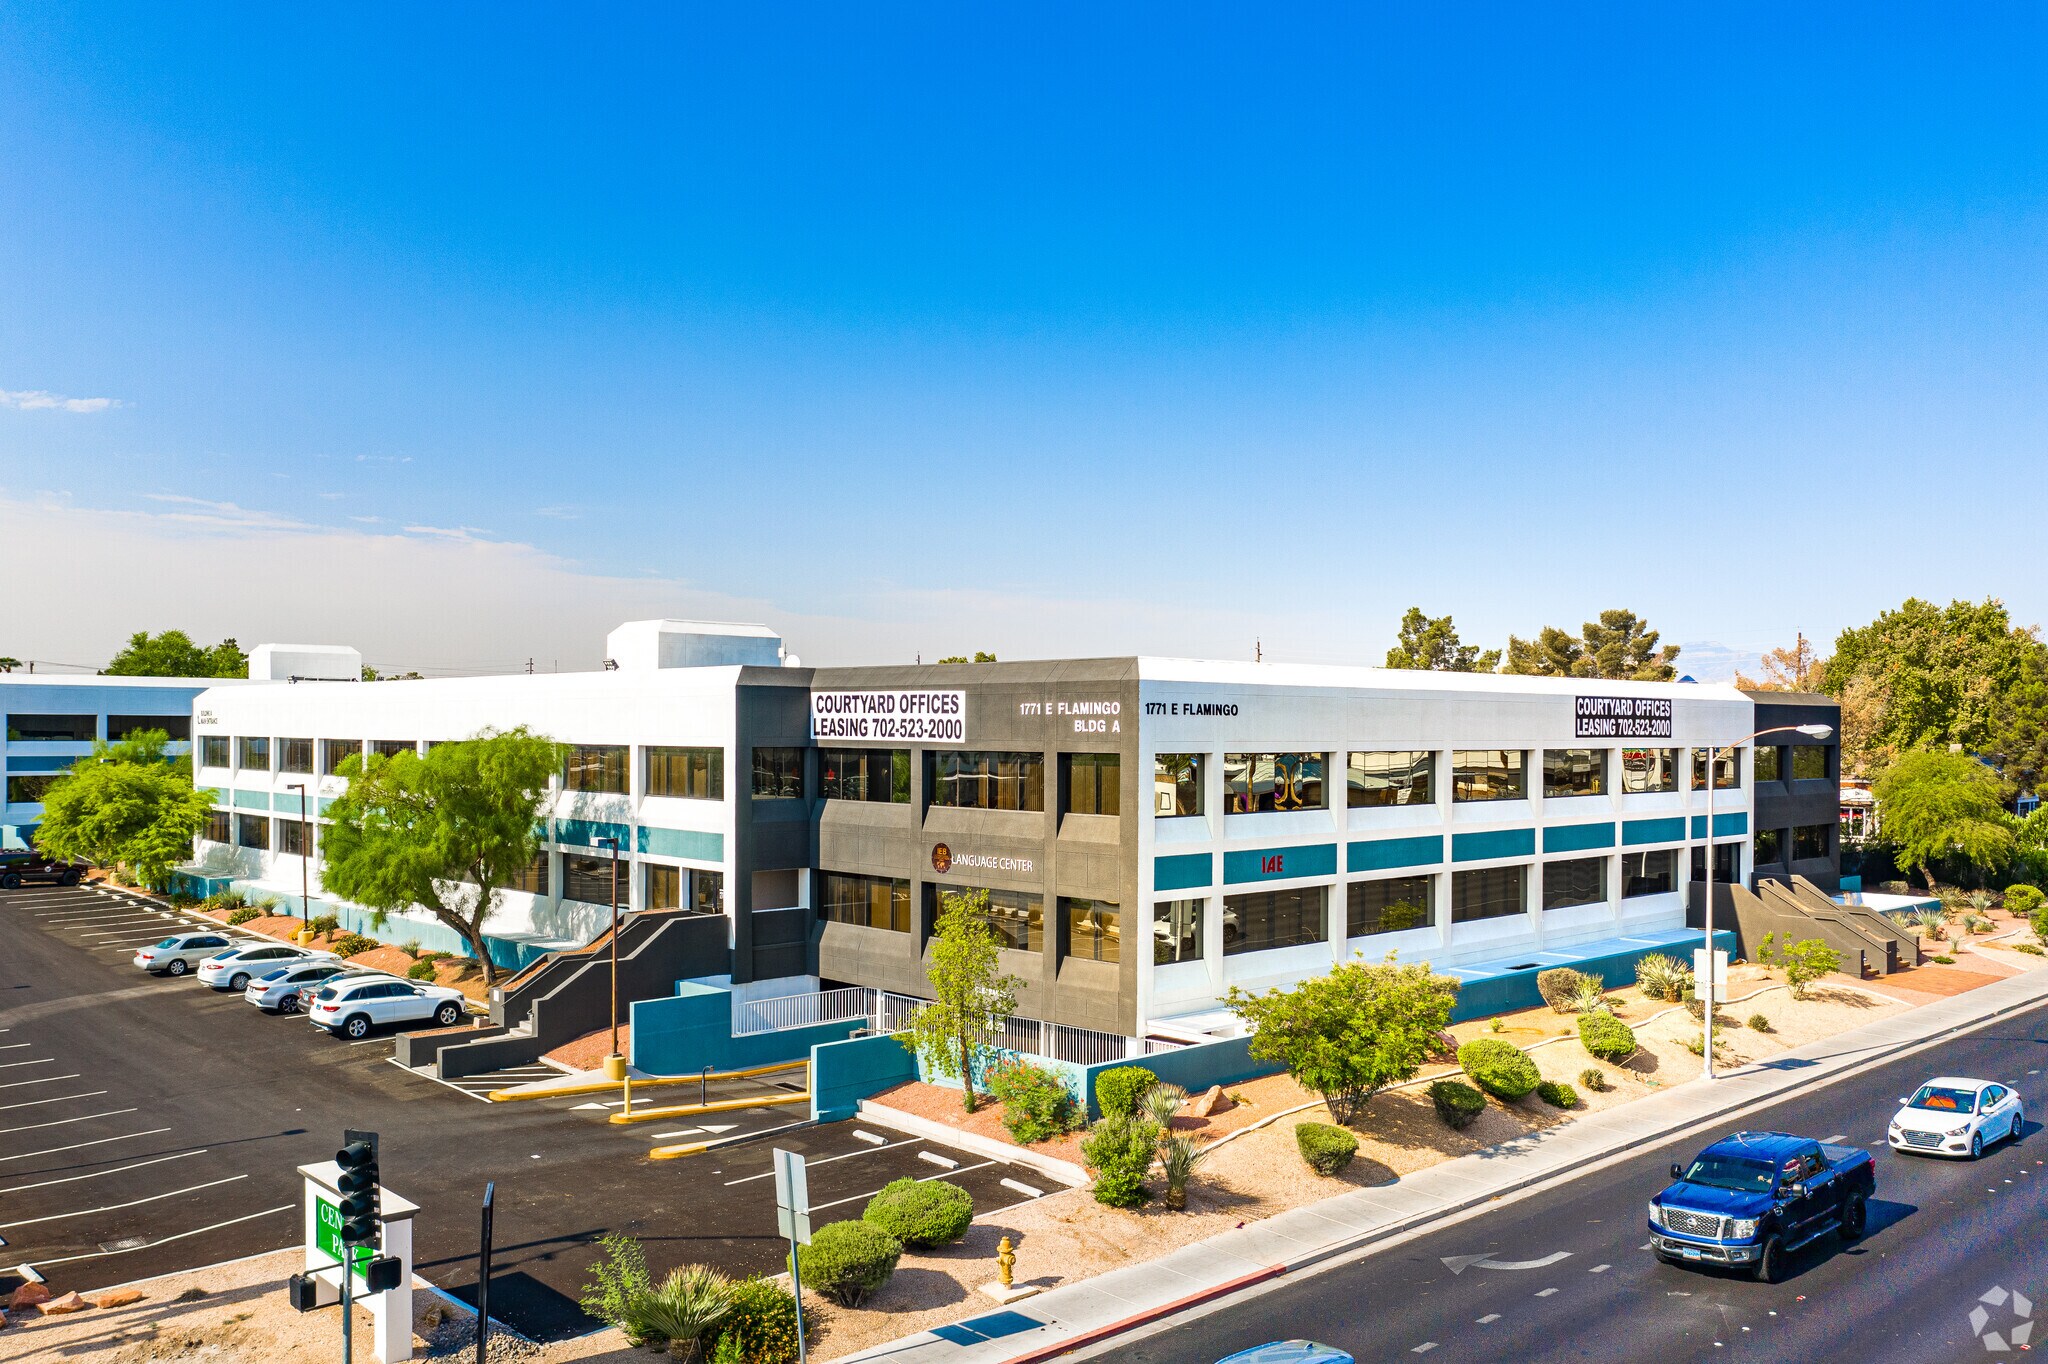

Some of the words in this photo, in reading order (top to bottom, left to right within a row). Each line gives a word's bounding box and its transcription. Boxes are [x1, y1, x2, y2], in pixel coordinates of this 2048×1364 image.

[816, 695, 895, 714] COURTYARD
[899, 694, 959, 714] OFFICES
[1020, 703, 1041, 715] 1771
[1045, 702, 1052, 715] E
[1057, 702, 1120, 715] FLAMINGO
[1145, 703, 1166, 715] 1771
[1171, 703, 1178, 715] E
[1182, 703, 1239, 716] FLAMINGO
[1577, 698, 1633, 716] COURTYARD
[1635, 700, 1670, 717] OFFICES
[813, 718, 868, 737] LEASING
[872, 718, 962, 739] 702-523-2000
[1074, 720, 1106, 732] BLDG
[1112, 720, 1120, 732] A
[1577, 719, 1616, 736] LEASING
[1618, 719, 1670, 736] 702-523-2000
[952, 853, 998, 869] LANGUAGE
[999, 857, 1033, 872] CENTER
[1262, 855, 1283, 873] IAE
[332, 1233, 360, 1269] PAK
